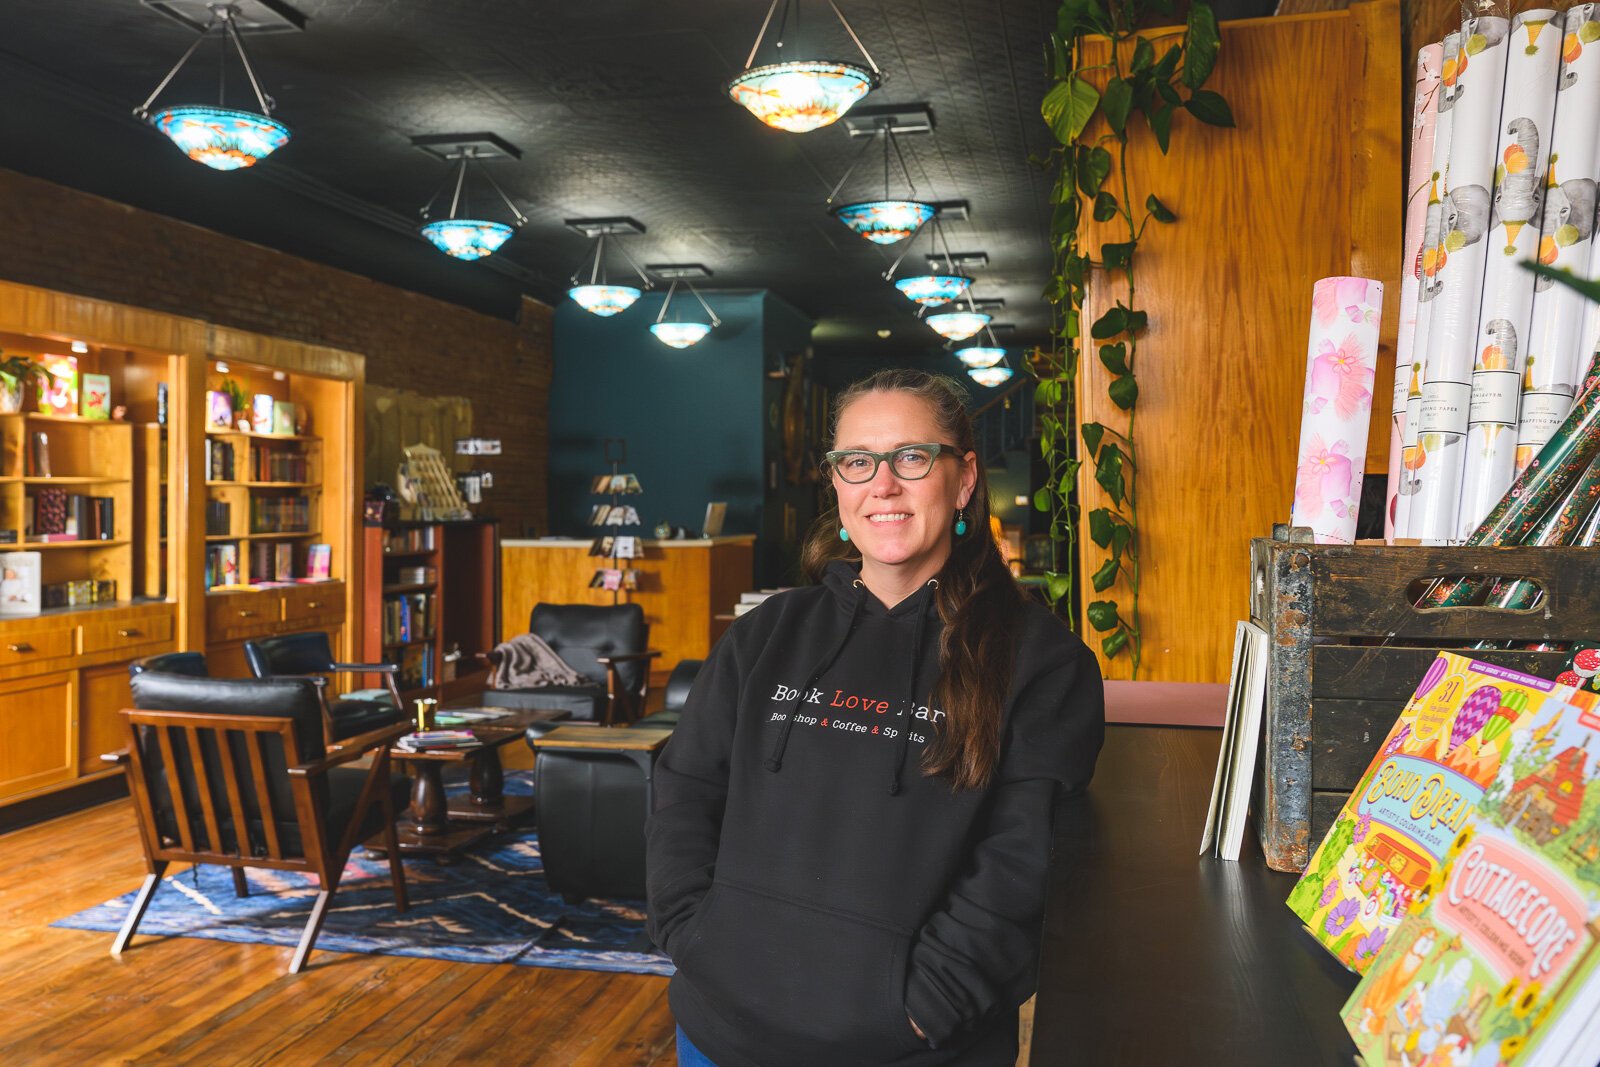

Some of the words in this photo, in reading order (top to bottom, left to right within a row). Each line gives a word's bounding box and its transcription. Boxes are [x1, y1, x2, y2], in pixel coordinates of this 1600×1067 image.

[830, 689, 889, 714] Love
[896, 701, 946, 723] ar
[1438, 681, 1459, 703] 31
[770, 712, 818, 726] Boohop
[820, 718, 829, 727] &
[832, 719, 868, 733] Coffee
[871, 725, 879, 735] &
[883, 727, 925, 743] Spits
[1367, 761, 1423, 804] BOHO
[1398, 818, 1426, 837] COLORING
[1425, 832, 1442, 846] BOOK
[1448, 844, 1576, 979] COTTAGECORE
